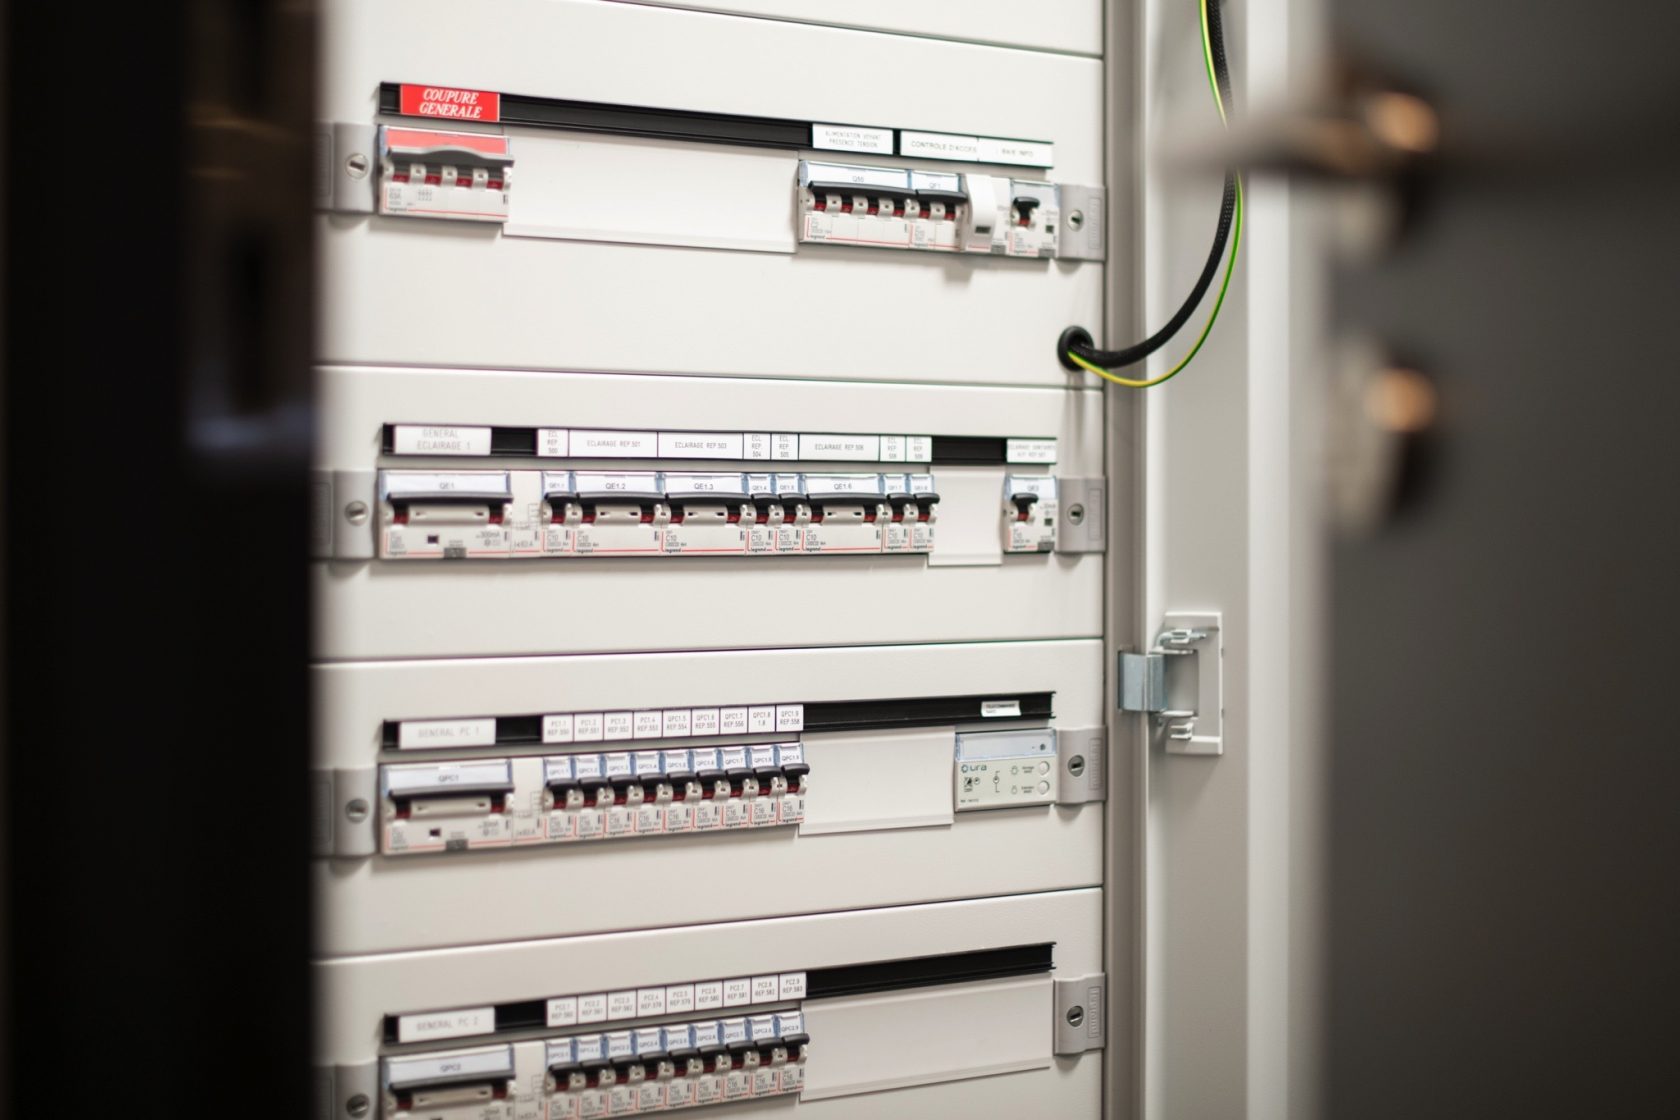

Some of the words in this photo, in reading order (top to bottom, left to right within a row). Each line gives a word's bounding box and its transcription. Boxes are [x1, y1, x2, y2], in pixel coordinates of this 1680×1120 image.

[423, 88, 479, 105] COUPURE
[419, 102, 482, 119] GENERALE
[911, 140, 946, 150] CONTROLE
[422, 428, 459, 438] GENERAL
[416, 440, 461, 451] ECLAIRAGE
[586, 439, 617, 447] ECLAIRAGE
[674, 441, 704, 449] ECLAIRAGE
[439, 482, 455, 490] QE1
[605, 482, 626, 490] QE1.2
[694, 482, 714, 490] QE1.3
[833, 482, 852, 490] QE1.6
[438, 774, 459, 783] QPC1
